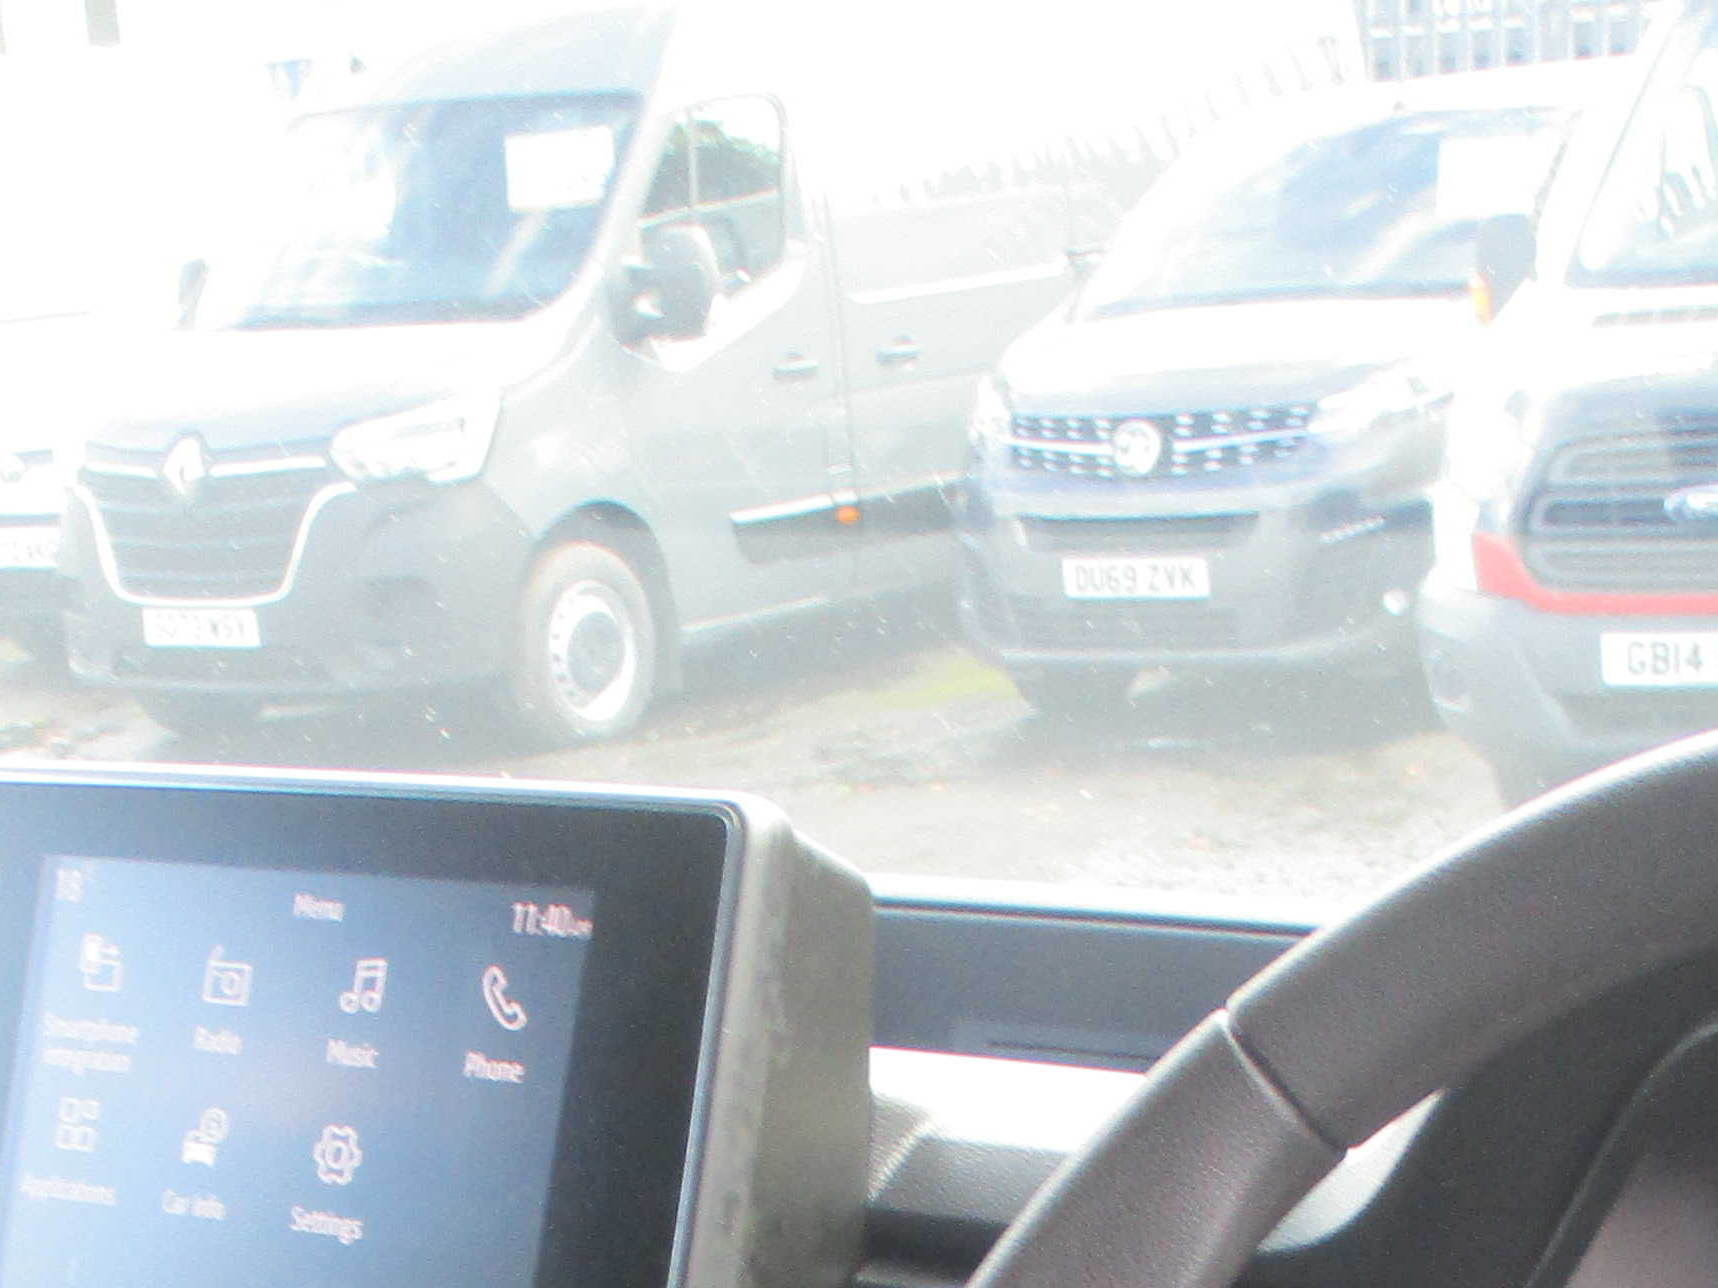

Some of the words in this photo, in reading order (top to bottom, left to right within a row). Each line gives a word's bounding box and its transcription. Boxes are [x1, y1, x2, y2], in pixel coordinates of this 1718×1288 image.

[1145, 562, 1197, 593] ZVK
[1626, 640, 1704, 676] GB14
[293, 893, 345, 922] Menu
[326, 1038, 379, 1069] Music
[464, 1050, 526, 1084] Phone
[289, 1204, 365, 1246] Settings
